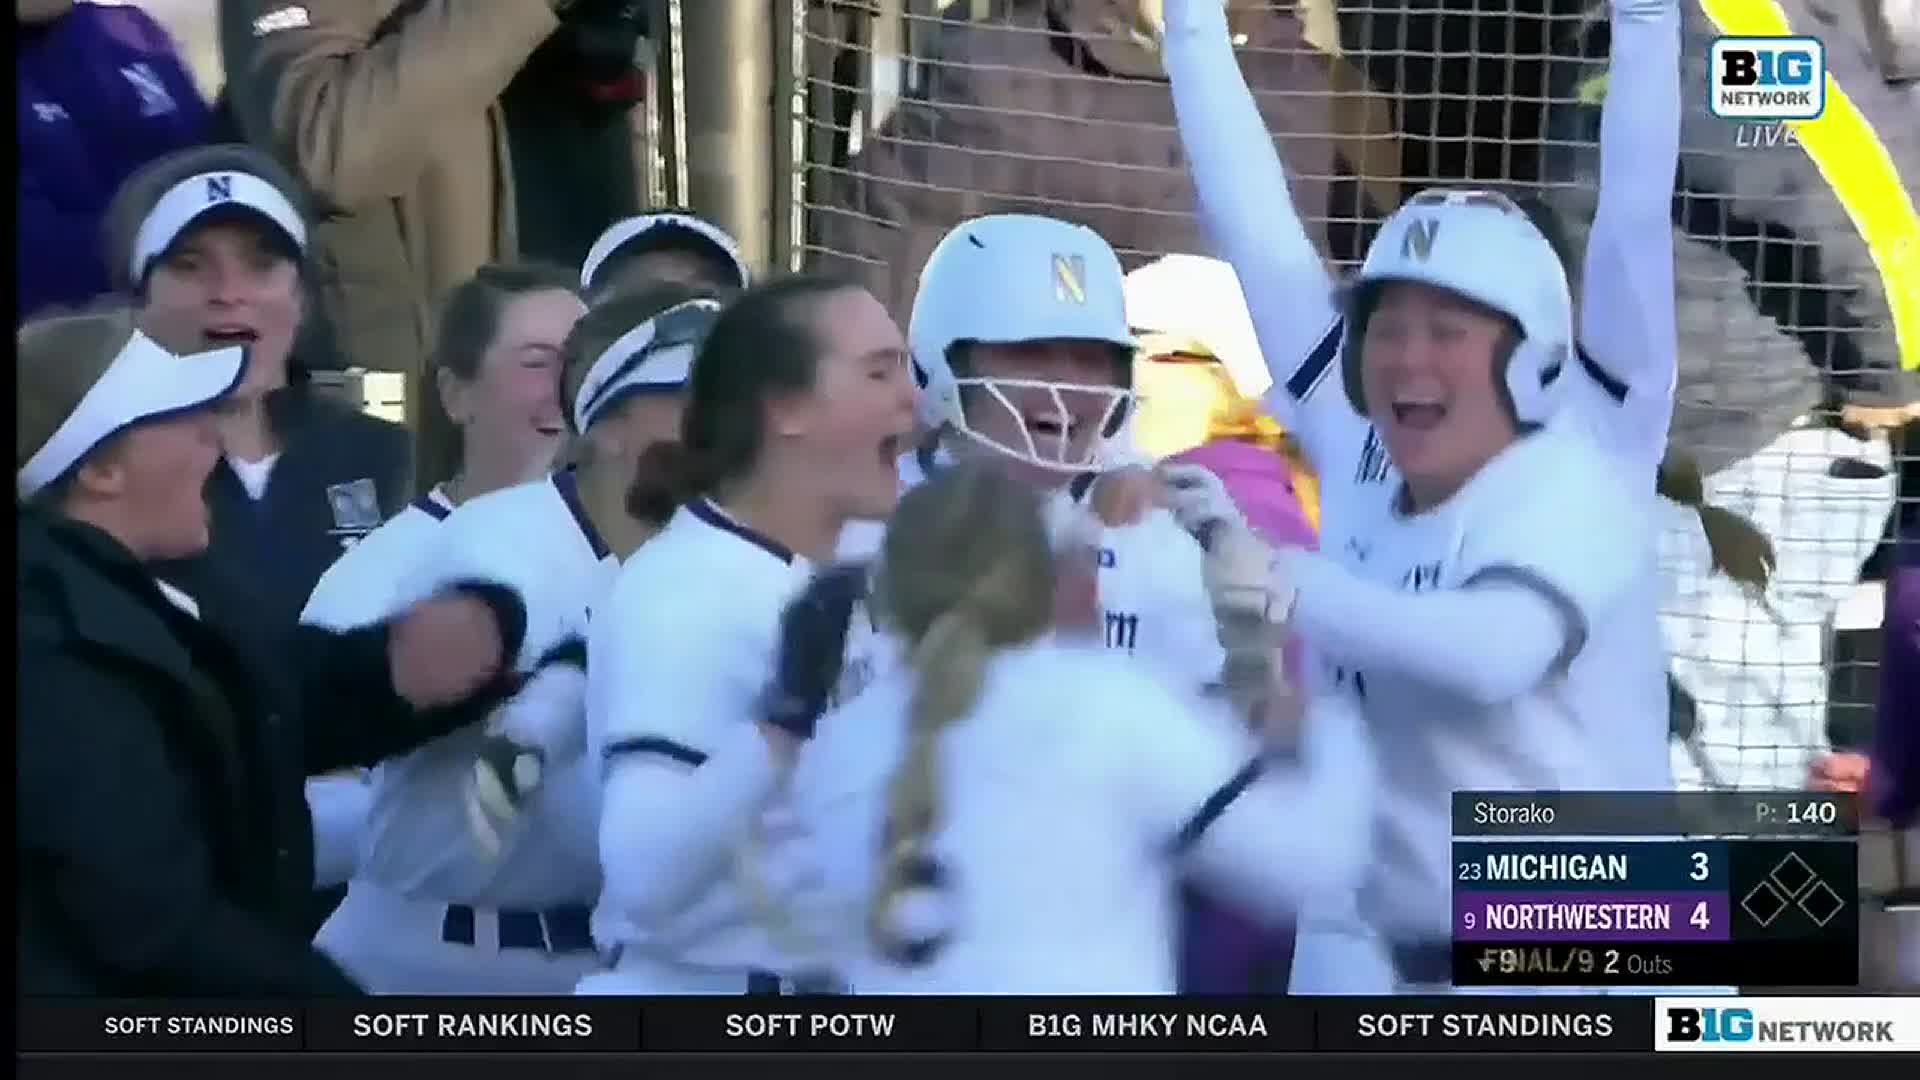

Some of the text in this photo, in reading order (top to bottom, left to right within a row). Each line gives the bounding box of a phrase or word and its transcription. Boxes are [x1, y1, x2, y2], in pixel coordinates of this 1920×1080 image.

[207, 175, 231, 202] N
[1402, 218, 1440, 261] N
[1051, 253, 1087, 304] N
